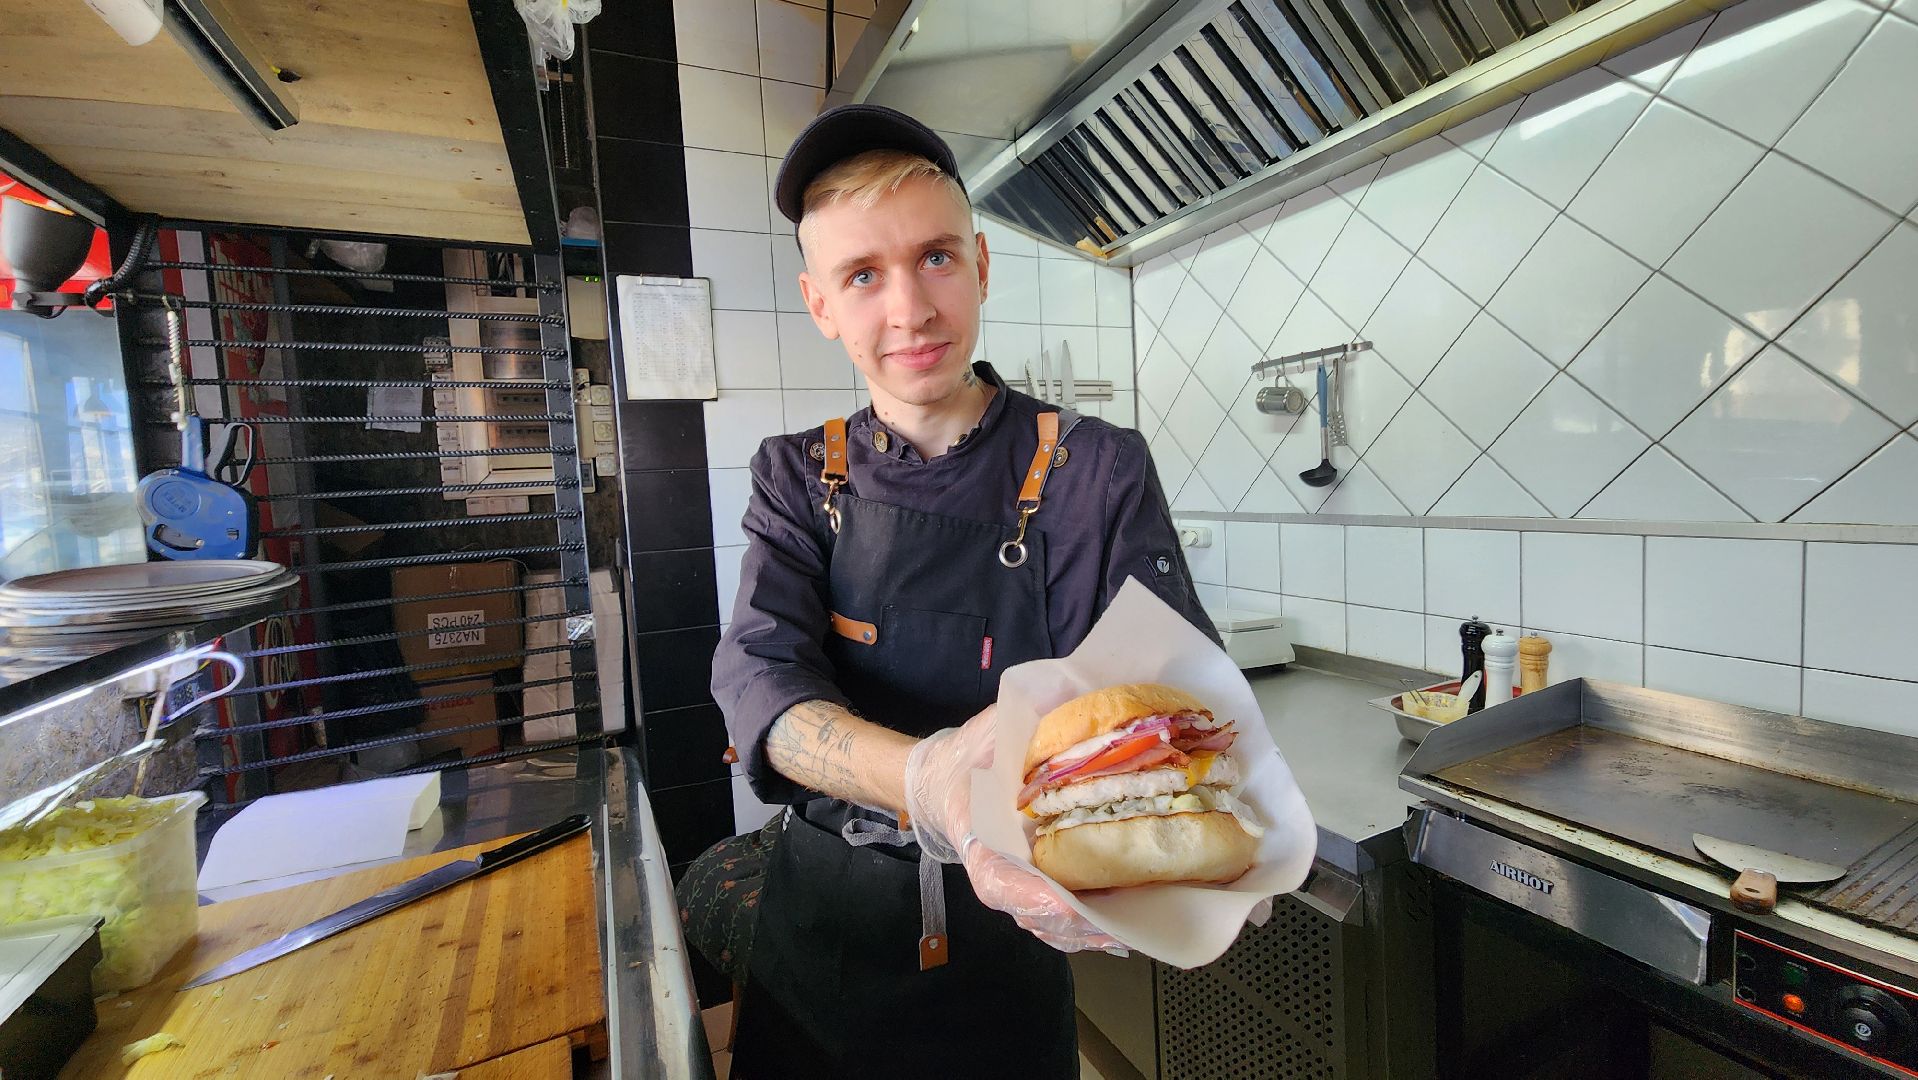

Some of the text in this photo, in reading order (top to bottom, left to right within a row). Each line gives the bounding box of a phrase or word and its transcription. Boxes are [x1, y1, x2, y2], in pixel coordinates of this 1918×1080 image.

[432, 613, 480, 630] 240 PCS
[434, 630, 480, 646] NA2375
[1489, 859, 1555, 895] AIRHOT
